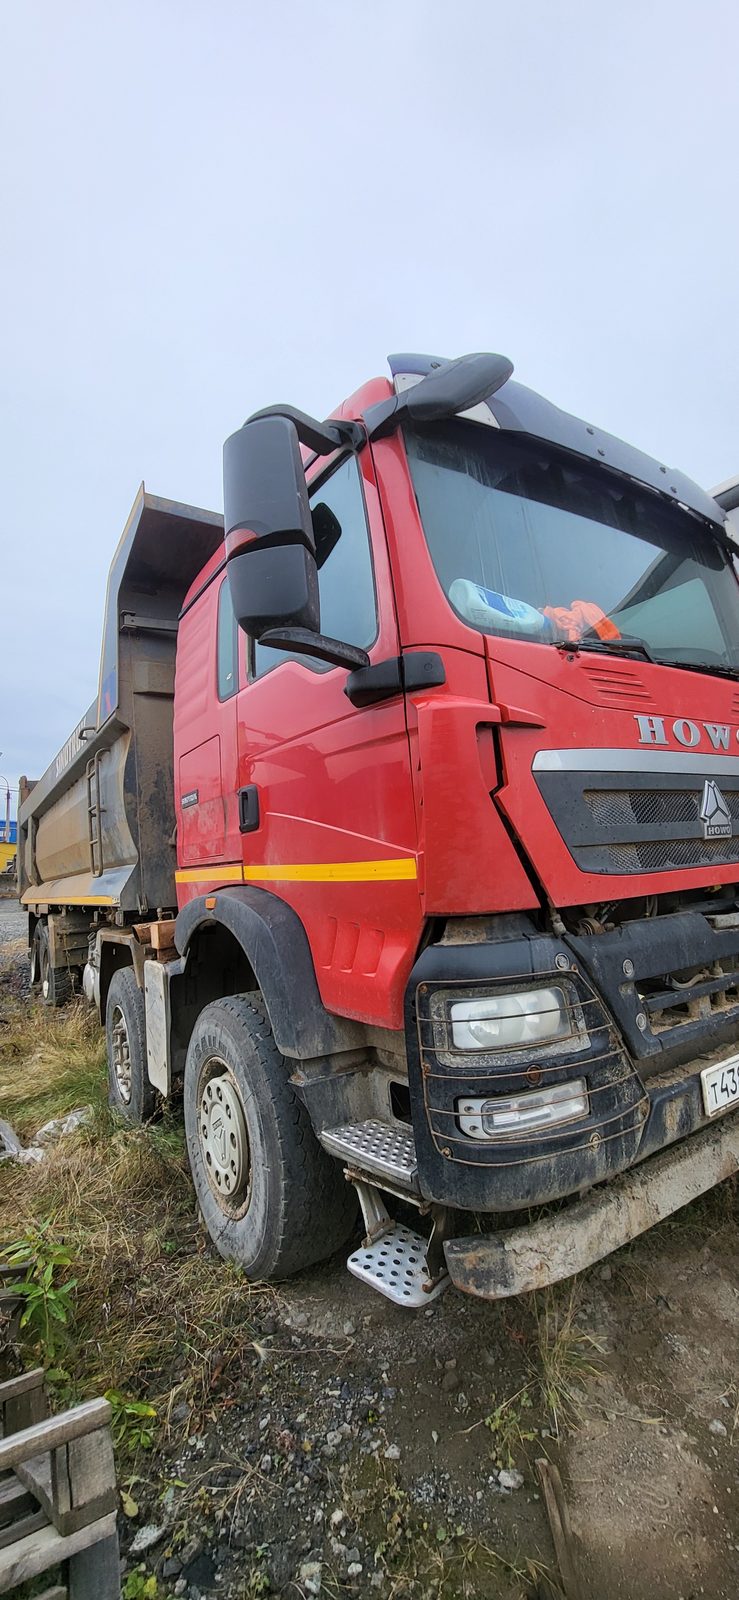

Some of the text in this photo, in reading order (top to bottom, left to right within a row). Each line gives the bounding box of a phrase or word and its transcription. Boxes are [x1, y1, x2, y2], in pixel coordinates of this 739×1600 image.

[633, 715, 739, 751] HOW
[708, 825, 731, 835] HOWO
[711, 1066, 739, 1104] T43
